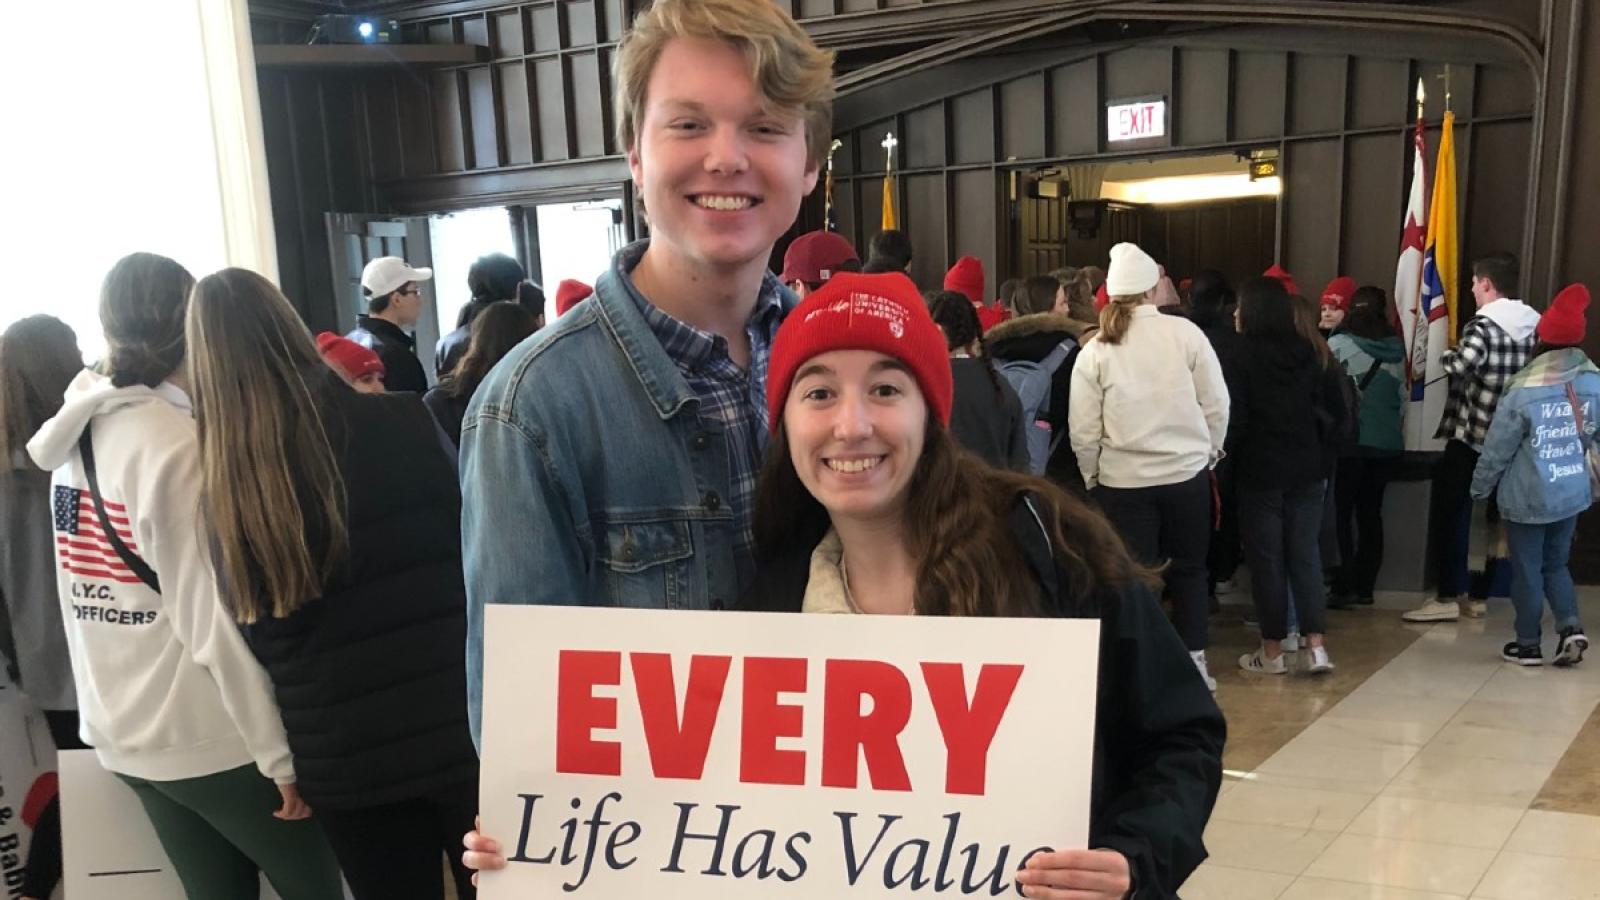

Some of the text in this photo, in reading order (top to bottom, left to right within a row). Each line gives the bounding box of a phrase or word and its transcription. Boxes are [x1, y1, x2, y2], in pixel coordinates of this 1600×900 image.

[1120, 106, 1154, 135] EXIT
[867, 309, 904, 325] AMERICA
[1539, 442, 1576, 459] Have
[1548, 463, 1584, 482] Jesus
[72, 603, 157, 625] OFFICERS
[556, 650, 1025, 796] EVERY
[507, 792, 641, 892] Life
[660, 802, 811, 882] Has
